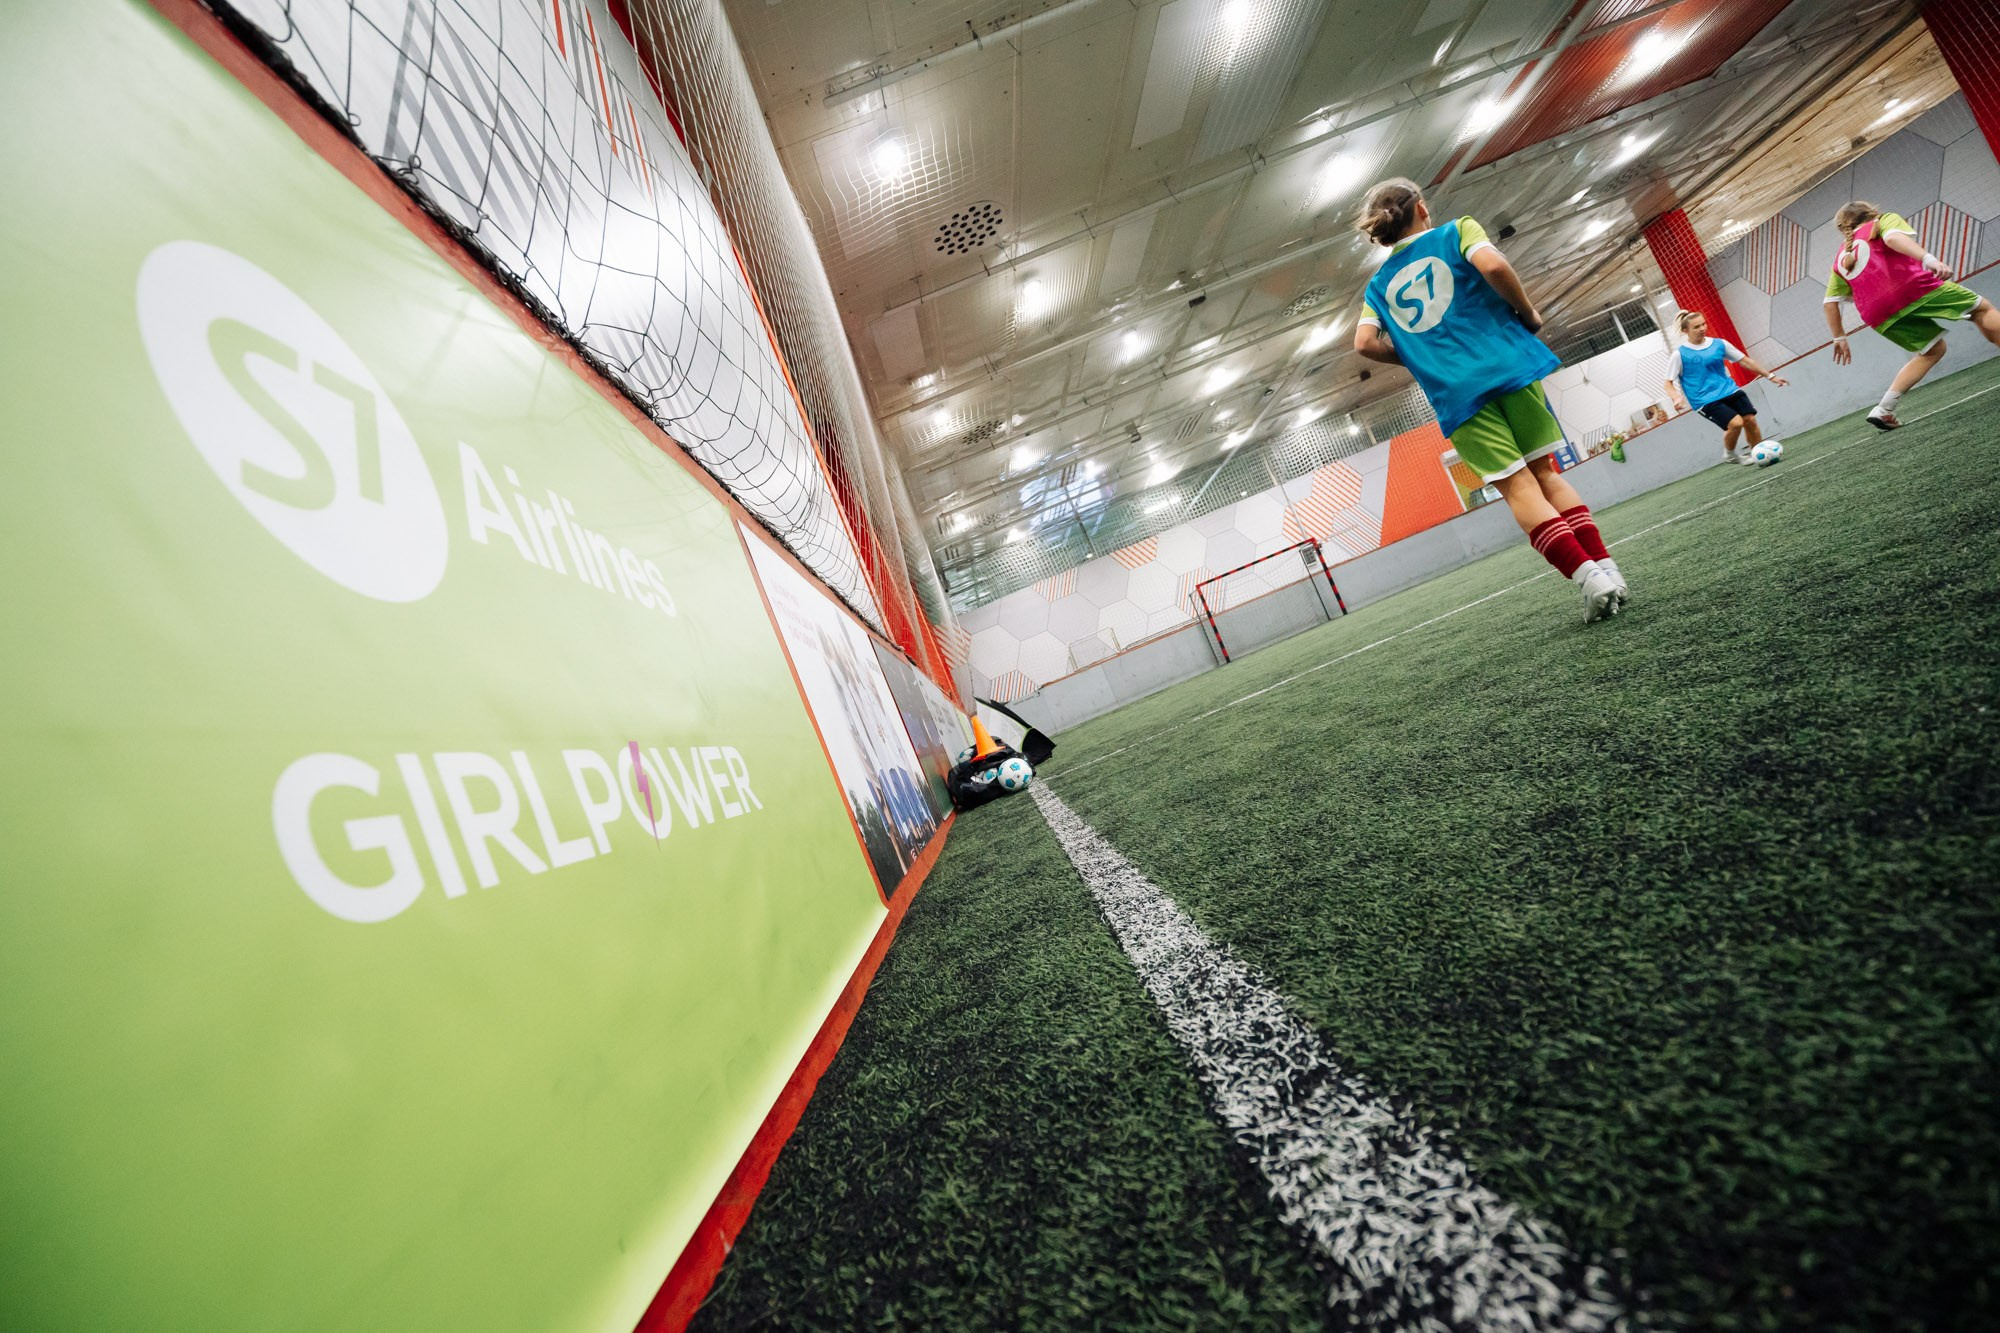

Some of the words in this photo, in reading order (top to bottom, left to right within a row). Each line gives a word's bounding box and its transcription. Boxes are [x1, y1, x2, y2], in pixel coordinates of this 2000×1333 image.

[1395, 262, 1434, 328] S7
[207, 316, 385, 511] S7
[458, 440, 677, 618] Airlines
[272, 744, 763, 923] GIRLPOWER
